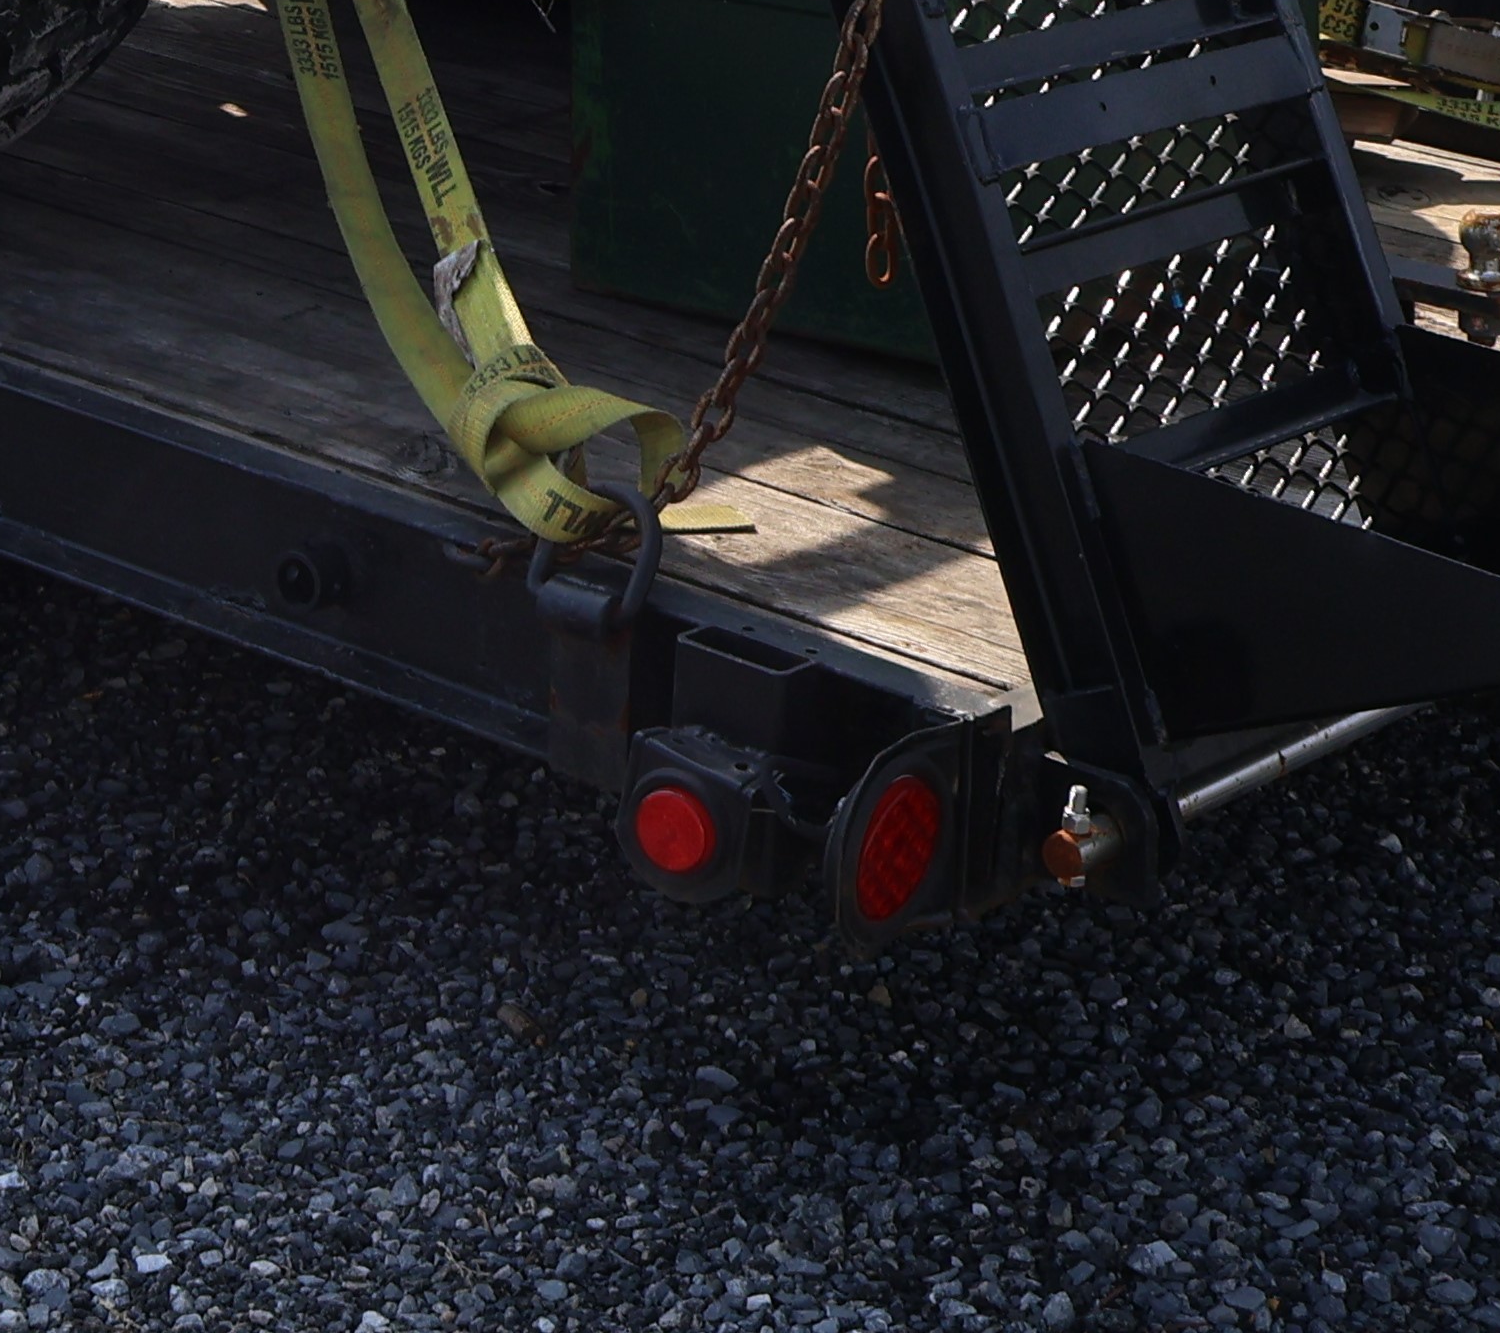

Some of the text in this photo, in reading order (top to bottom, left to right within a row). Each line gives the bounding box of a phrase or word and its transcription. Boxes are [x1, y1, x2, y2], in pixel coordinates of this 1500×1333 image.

[284, 4, 308, 37] LBS
[306, 6, 340, 81] 1515 KGS
[292, 39, 318, 78] 3333
[396, 101, 432, 171] 1515 KGS
[427, 121, 449, 156] LBS
[425, 154, 458, 208] WLL
